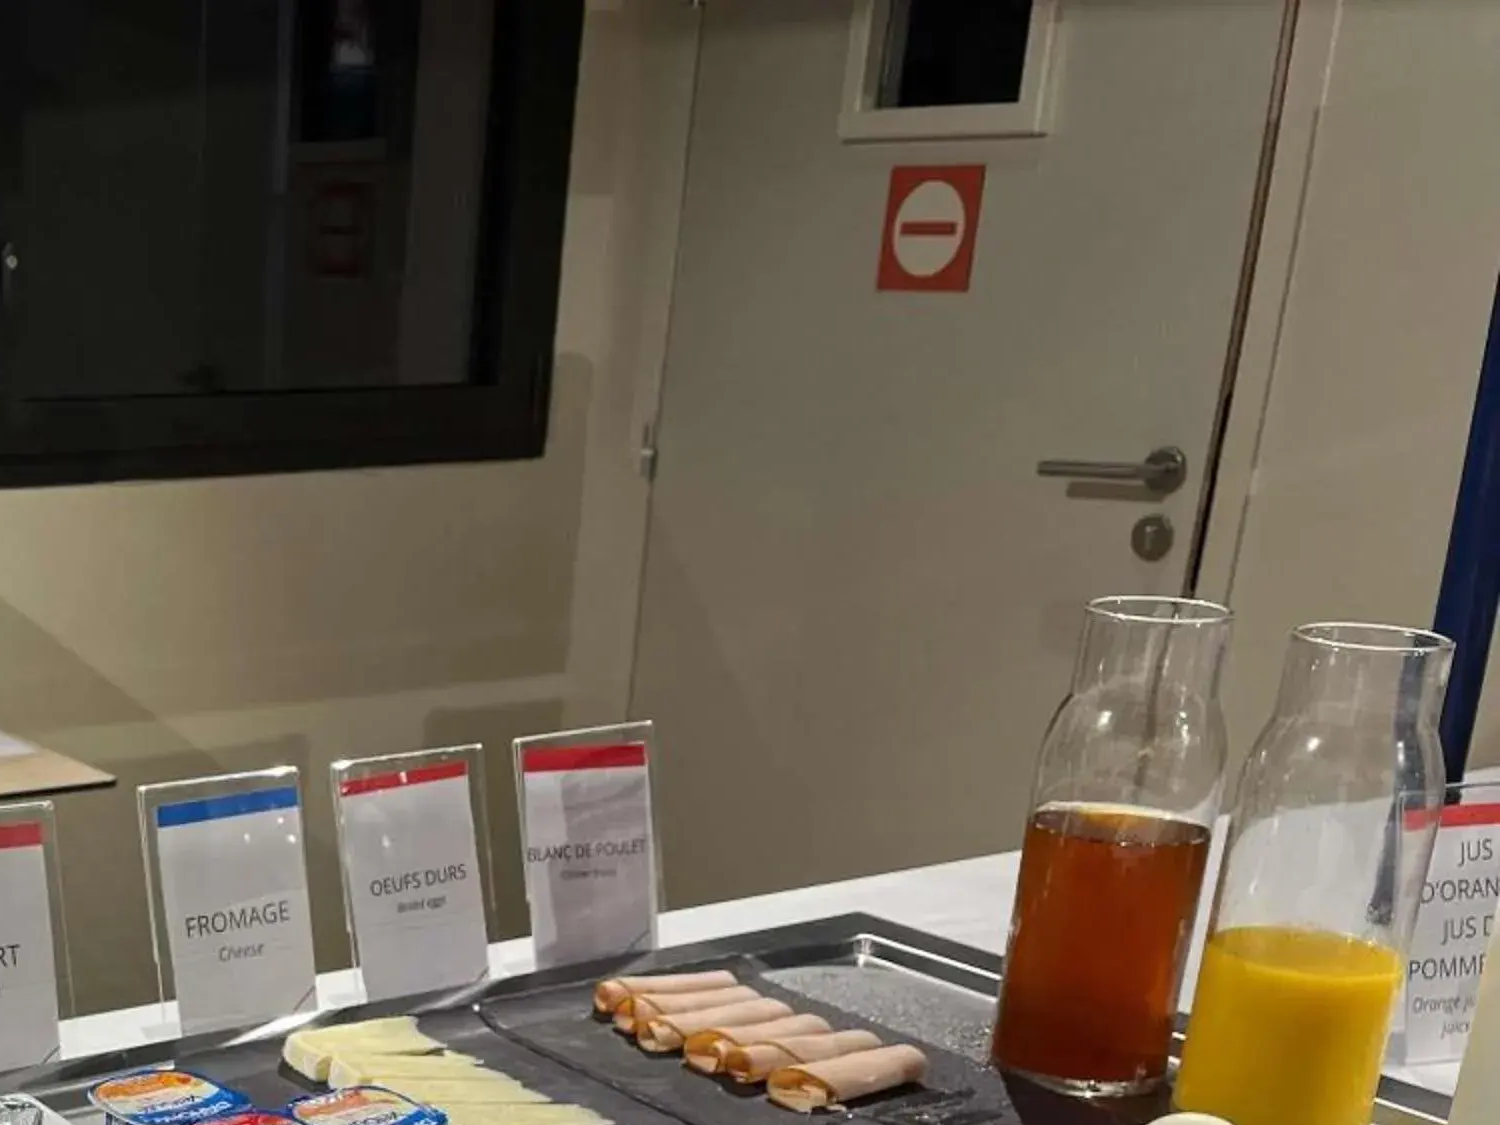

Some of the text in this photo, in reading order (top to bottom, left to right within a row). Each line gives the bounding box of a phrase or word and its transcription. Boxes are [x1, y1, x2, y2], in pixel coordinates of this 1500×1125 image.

[1457, 838, 1494, 868] JUS
[370, 864, 467, 897] OEUFS DURS
[184, 900, 291, 938] FROMAGE
[1441, 916, 1477, 946] JUS
